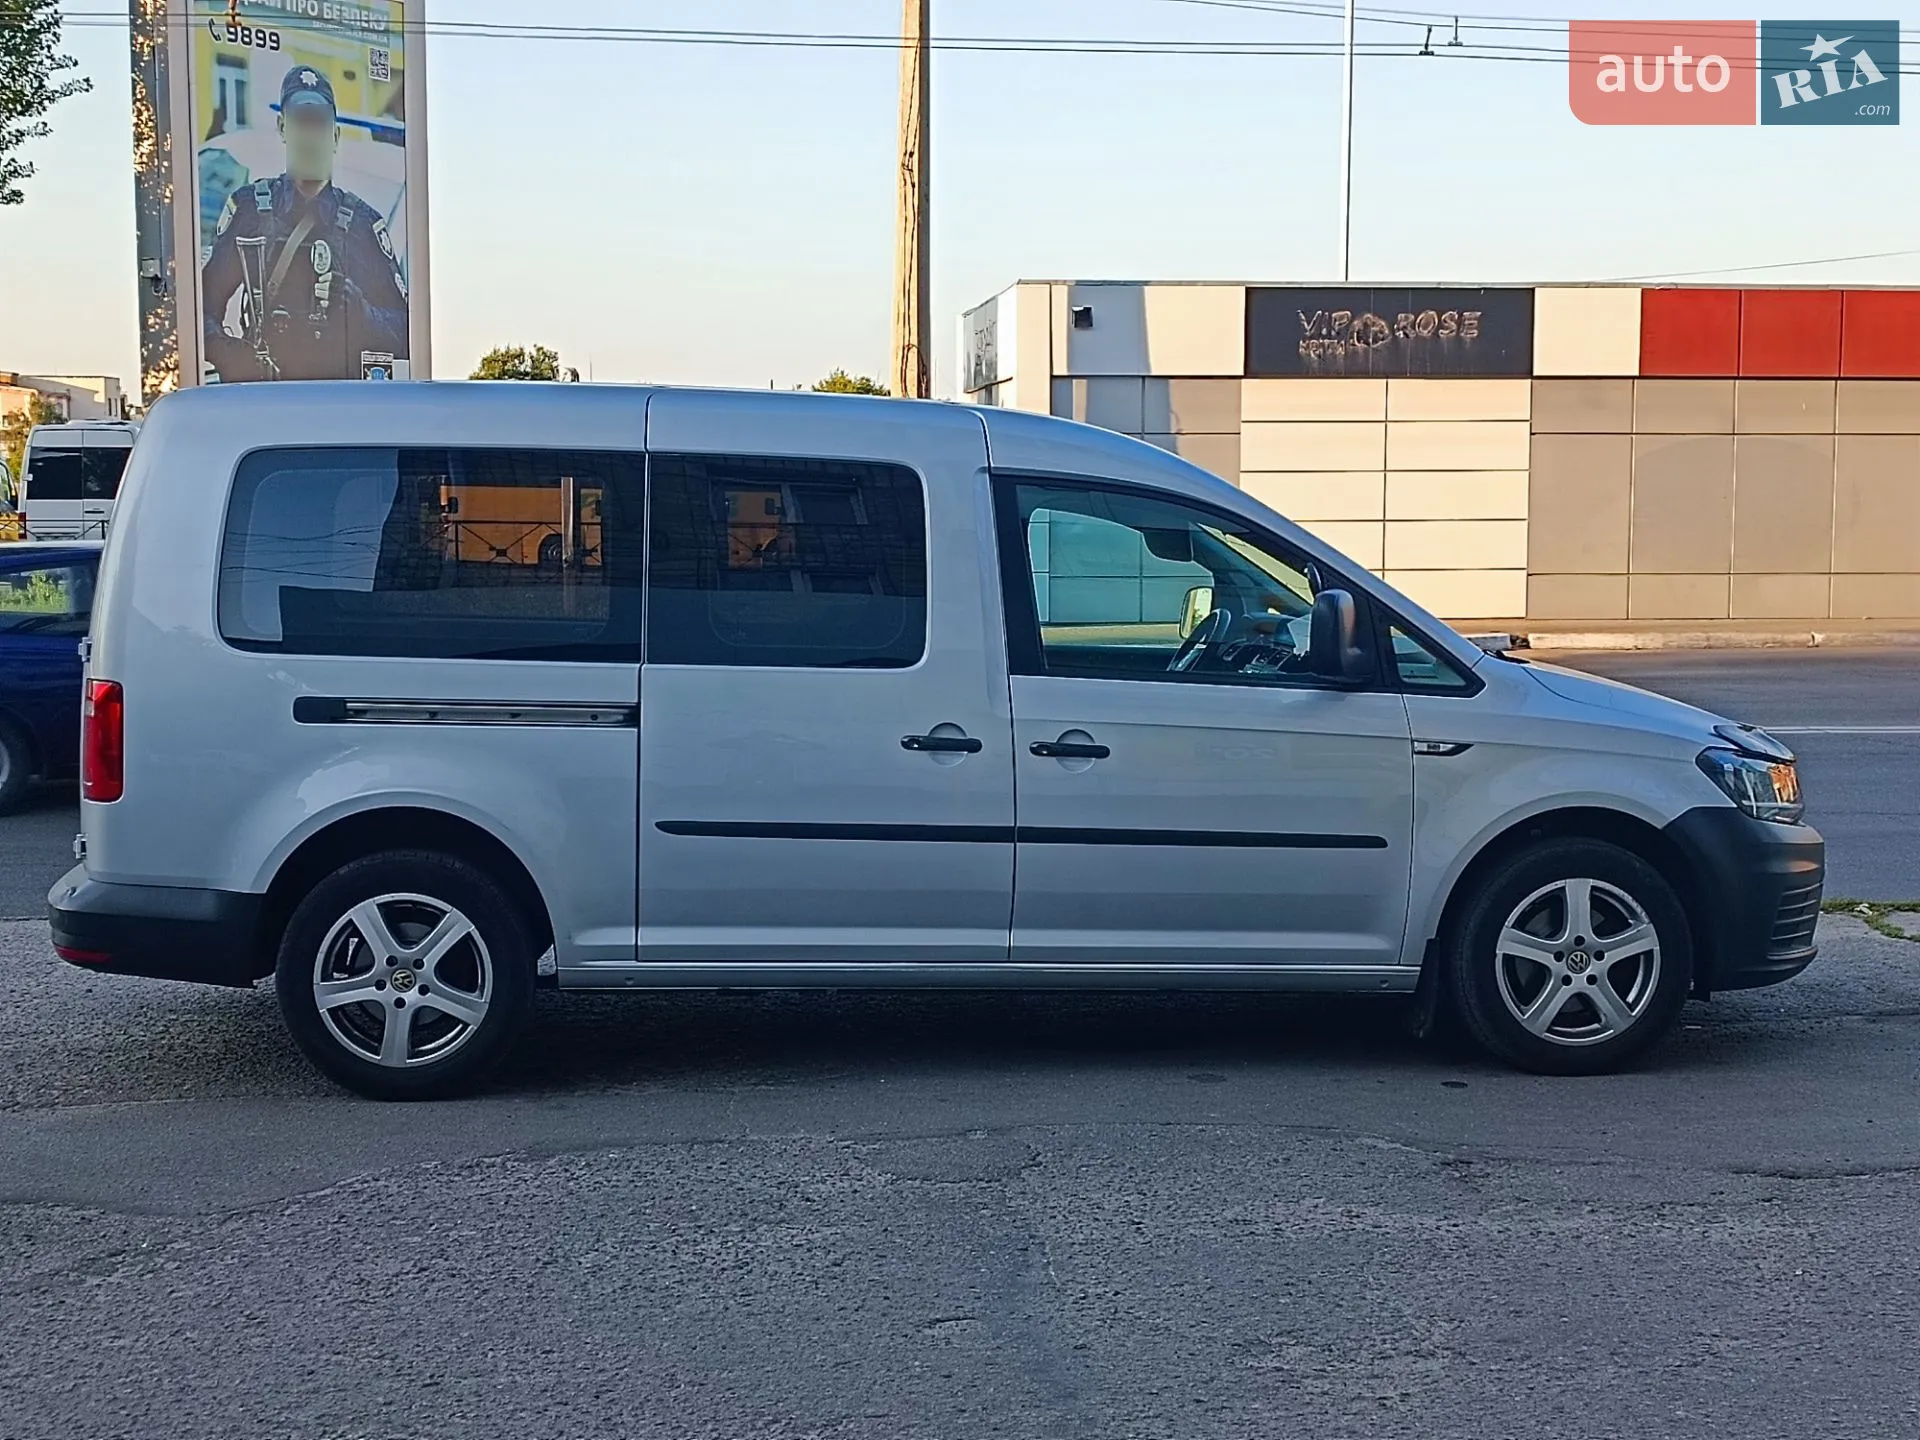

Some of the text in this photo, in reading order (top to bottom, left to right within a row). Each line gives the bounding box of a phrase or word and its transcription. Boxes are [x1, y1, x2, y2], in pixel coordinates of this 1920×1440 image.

[226, 26, 280, 51] 9899
[1296, 309, 1482, 338] VIP ROSE
